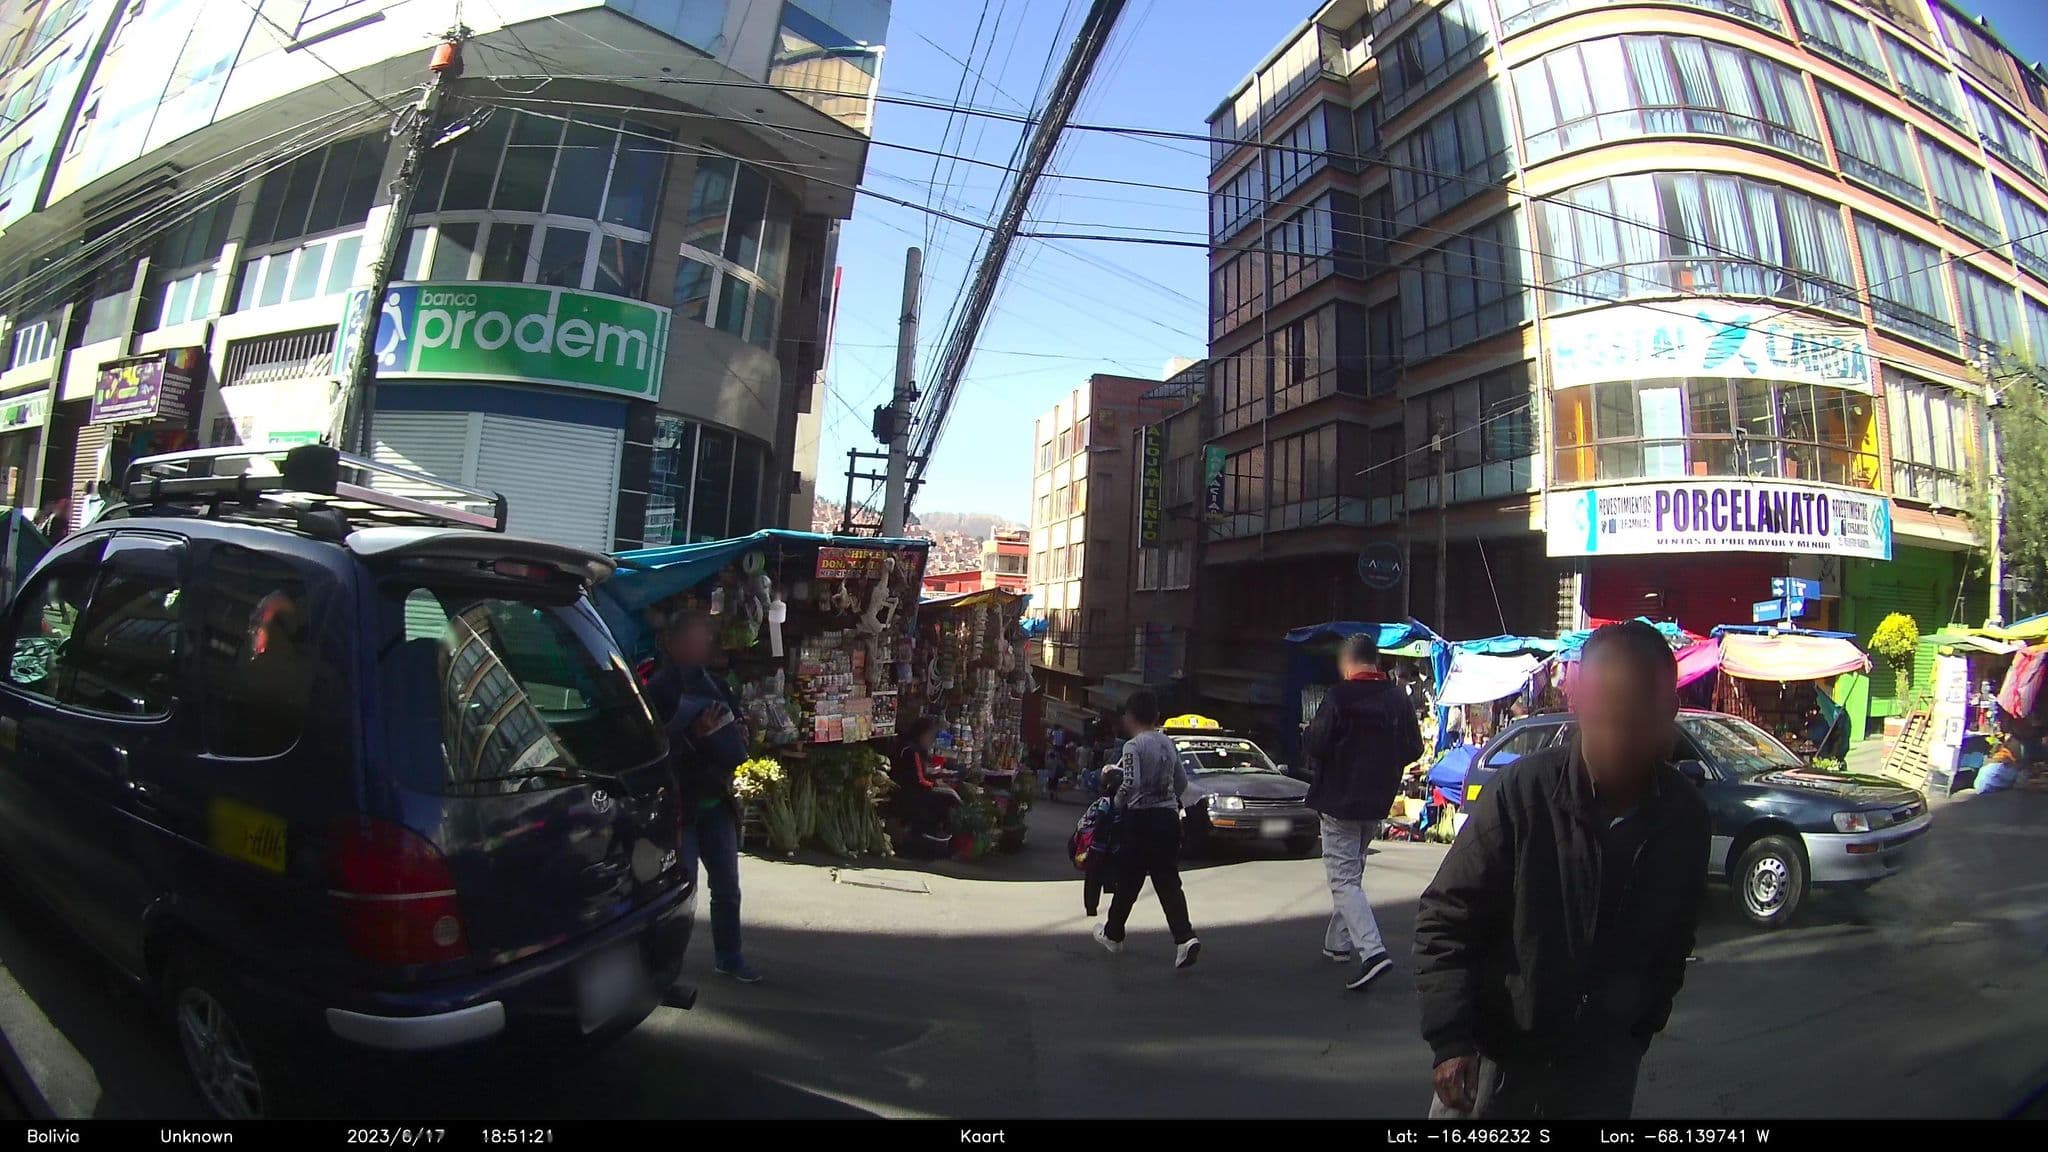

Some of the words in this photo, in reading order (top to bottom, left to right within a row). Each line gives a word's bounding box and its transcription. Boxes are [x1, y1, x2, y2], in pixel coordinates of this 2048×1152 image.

[420, 290, 477, 307] banco
[410, 289, 648, 373] prodem
[1143, 426, 1160, 540] ALOJAMIENTO
[1598, 495, 1652, 516] REVESTIMIENTOS
[1655, 488, 1830, 537] PORCELANATO
[1748, 539, 1786, 547] MAYOR
[1797, 541, 1831, 549] MENOR
